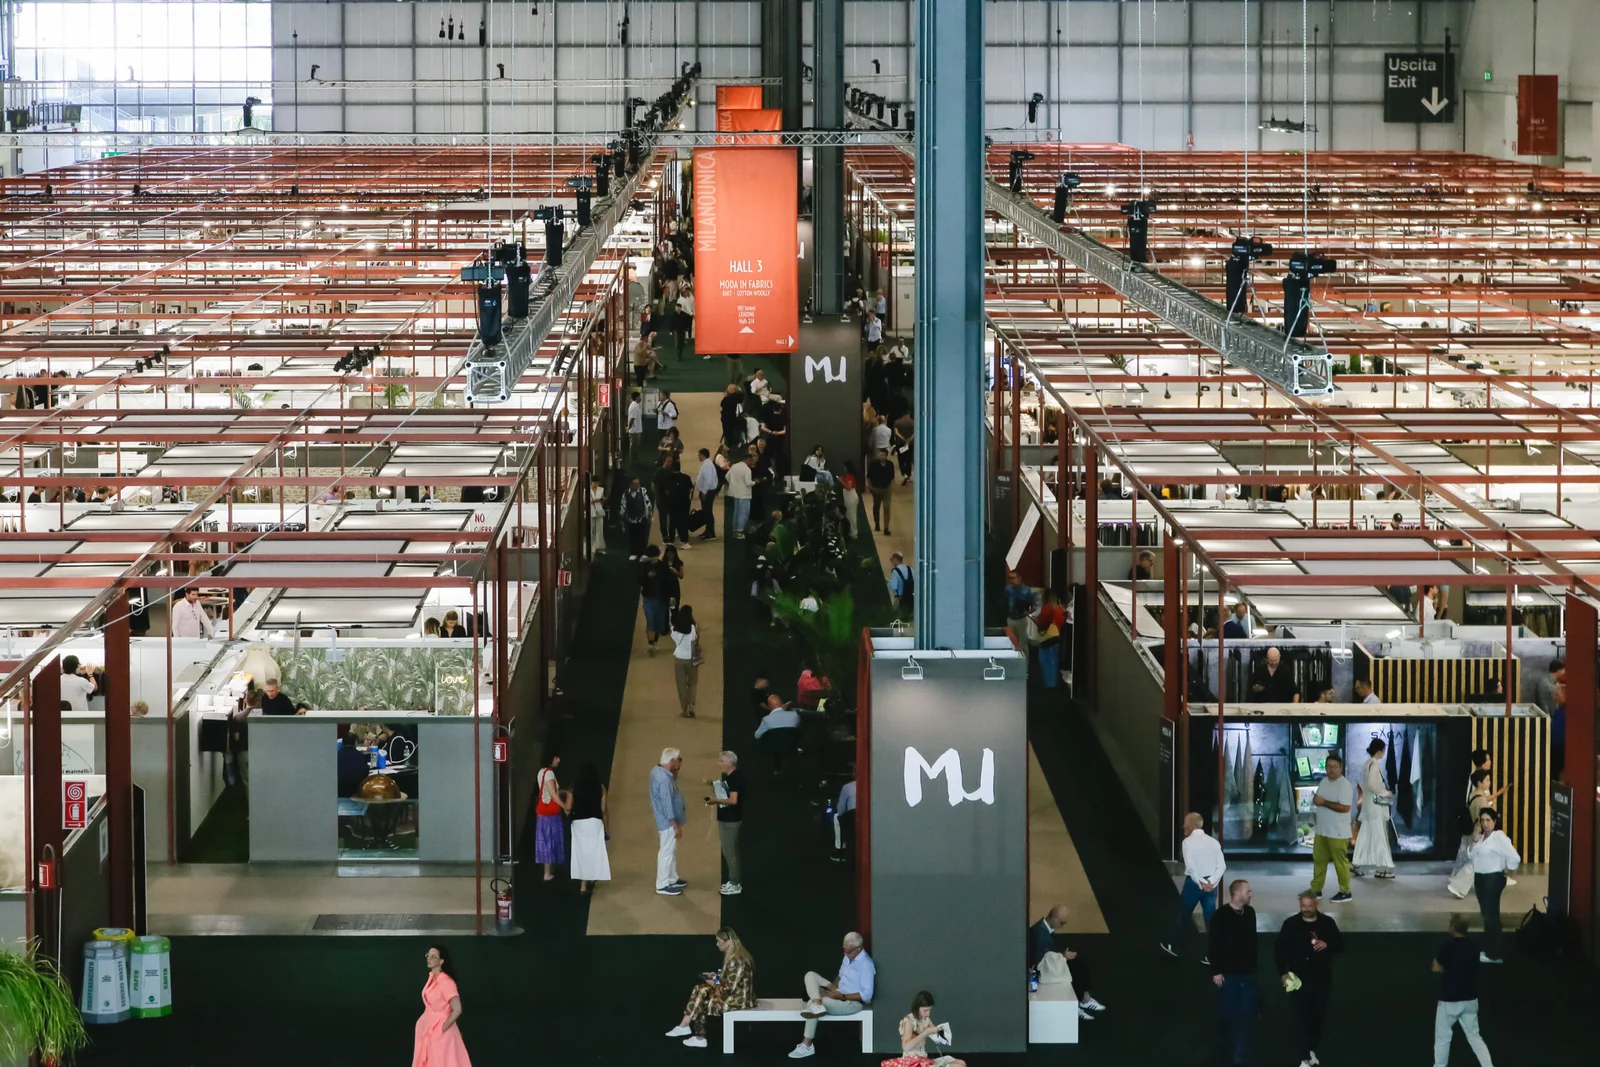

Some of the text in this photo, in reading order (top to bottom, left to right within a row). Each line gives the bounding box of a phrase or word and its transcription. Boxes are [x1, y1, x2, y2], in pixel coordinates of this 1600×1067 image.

[1388, 58, 1437, 71] Uscita
[1388, 75, 1417, 88] Exit
[697, 150, 716, 252] MILANOUNICA
[729, 260, 763, 273] HALL 3
[719, 279, 774, 289] MODA IN FABRICS
[805, 355, 847, 384] MU
[474, 513, 485, 523] NO
[440, 673, 469, 685] love
[904, 745, 995, 808] MU
